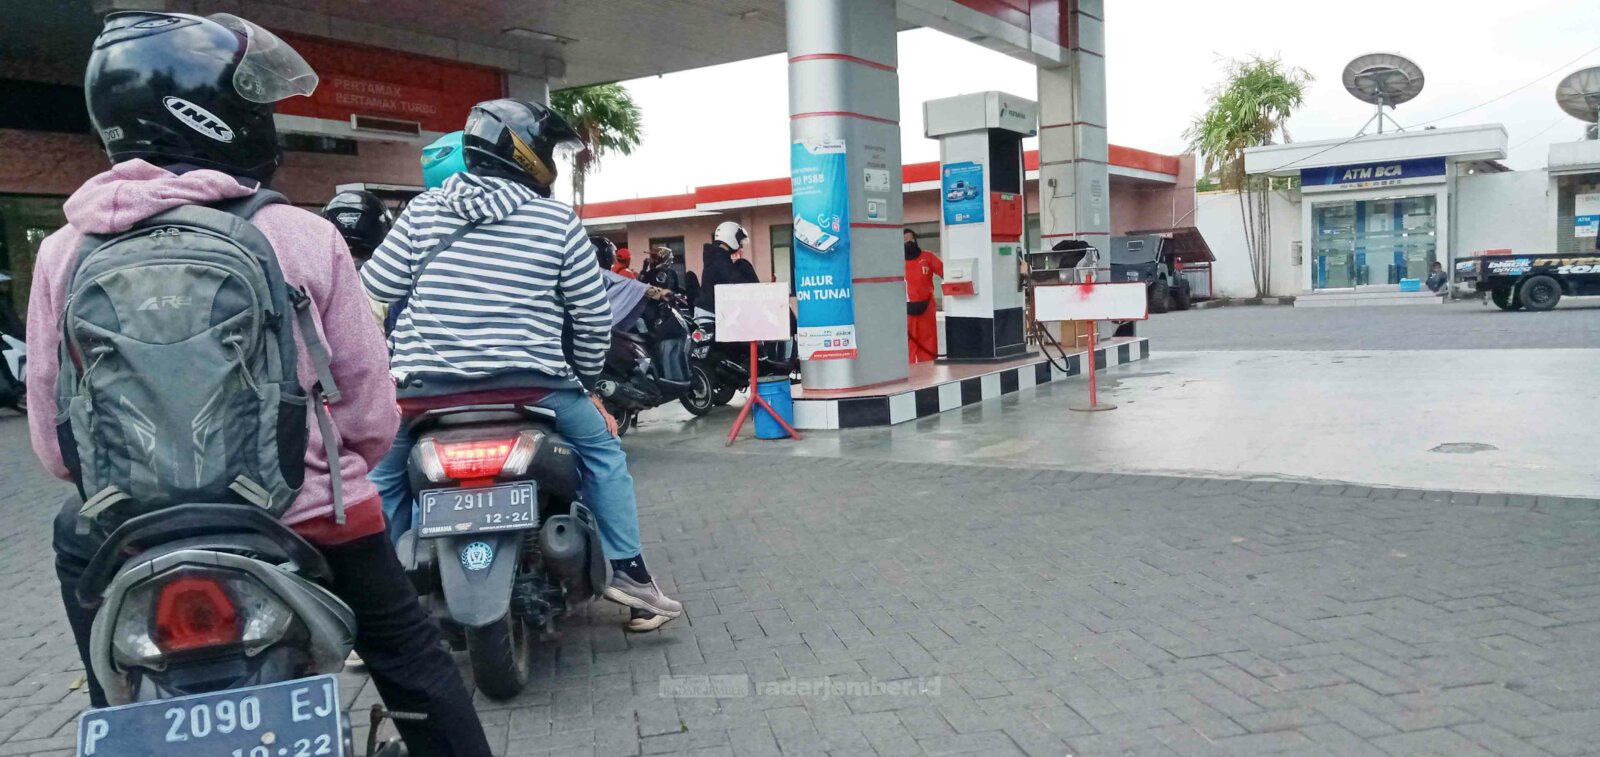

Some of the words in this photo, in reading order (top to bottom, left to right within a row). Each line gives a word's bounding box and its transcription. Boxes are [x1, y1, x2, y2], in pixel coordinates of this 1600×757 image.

[334, 79, 401, 97] PERTAMAX
[170, 102, 229, 136] INK
[103, 128, 121, 140] DOT
[803, 173, 825, 185] PSBB
[1343, 168, 1372, 180] ATM
[1374, 165, 1402, 177] BCA
[801, 275, 833, 287] JALUR
[813, 288, 850, 300] TUNAI
[426, 497, 436, 513] P
[453, 492, 494, 511] 2911
[510, 488, 530, 506] DF
[428, 525, 453, 533] YAMAHA
[84, 719, 110, 755] P
[164, 696, 261, 742] 2090
[290, 683, 333, 723] EJ
